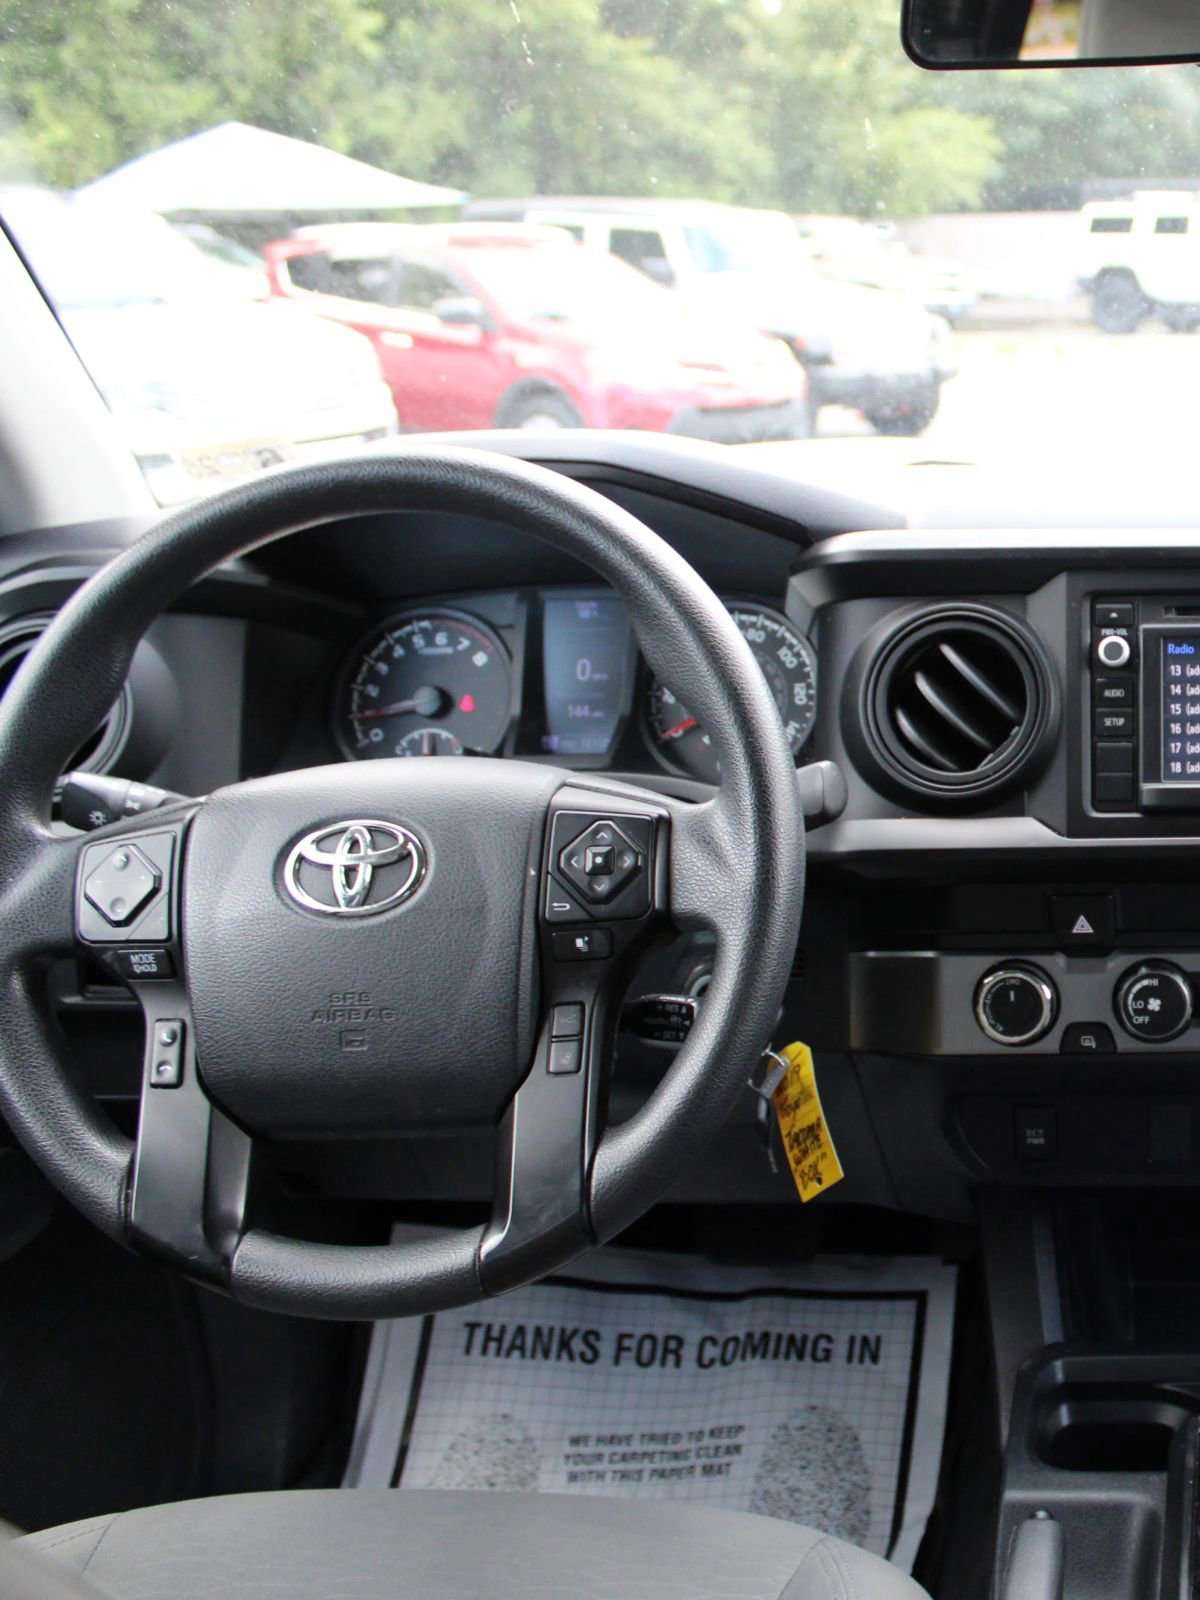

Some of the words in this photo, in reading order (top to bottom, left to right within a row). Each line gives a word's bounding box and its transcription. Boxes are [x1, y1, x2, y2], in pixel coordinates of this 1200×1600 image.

[1168, 643, 1195, 654] Radio
[777, 646, 798, 668] 100
[1170, 664, 1182, 676] 13
[794, 683, 807, 705] 120
[1104, 689, 1125, 697] AUDIO
[1170, 684, 1182, 696] 14
[1170, 704, 1182, 715] 15
[1104, 717, 1125, 726] SETUP
[1170, 723, 1182, 734] 16
[1170, 742, 1182, 754] 17
[1170, 762, 1182, 774] 18
[130, 953, 156, 963] MODE
[328, 991, 373, 1007] SRS
[1133, 1001, 1144, 1009] LO
[311, 1007, 396, 1023] AIRBAG
[463, 1322, 601, 1366] THANKS
[613, 1332, 685, 1369] FOR
[697, 1330, 834, 1369] COMING
[846, 1335, 882, 1366] IN
[569, 1434, 592, 1448] WE
[595, 1434, 634, 1447] HAVE
[640, 1432, 683, 1446] TRIED
[687, 1430, 704, 1443] TO
[709, 1424, 746, 1440] KEEP
[564, 1453, 604, 1466] YOUR
[608, 1450, 692, 1465] CARPETING
[695, 1444, 743, 1460] CLEAN
[567, 1470, 607, 1483] WITH
[611, 1469, 644, 1482] THIS
[649, 1465, 696, 1480] PAPER
[701, 1462, 732, 1477] MAT
